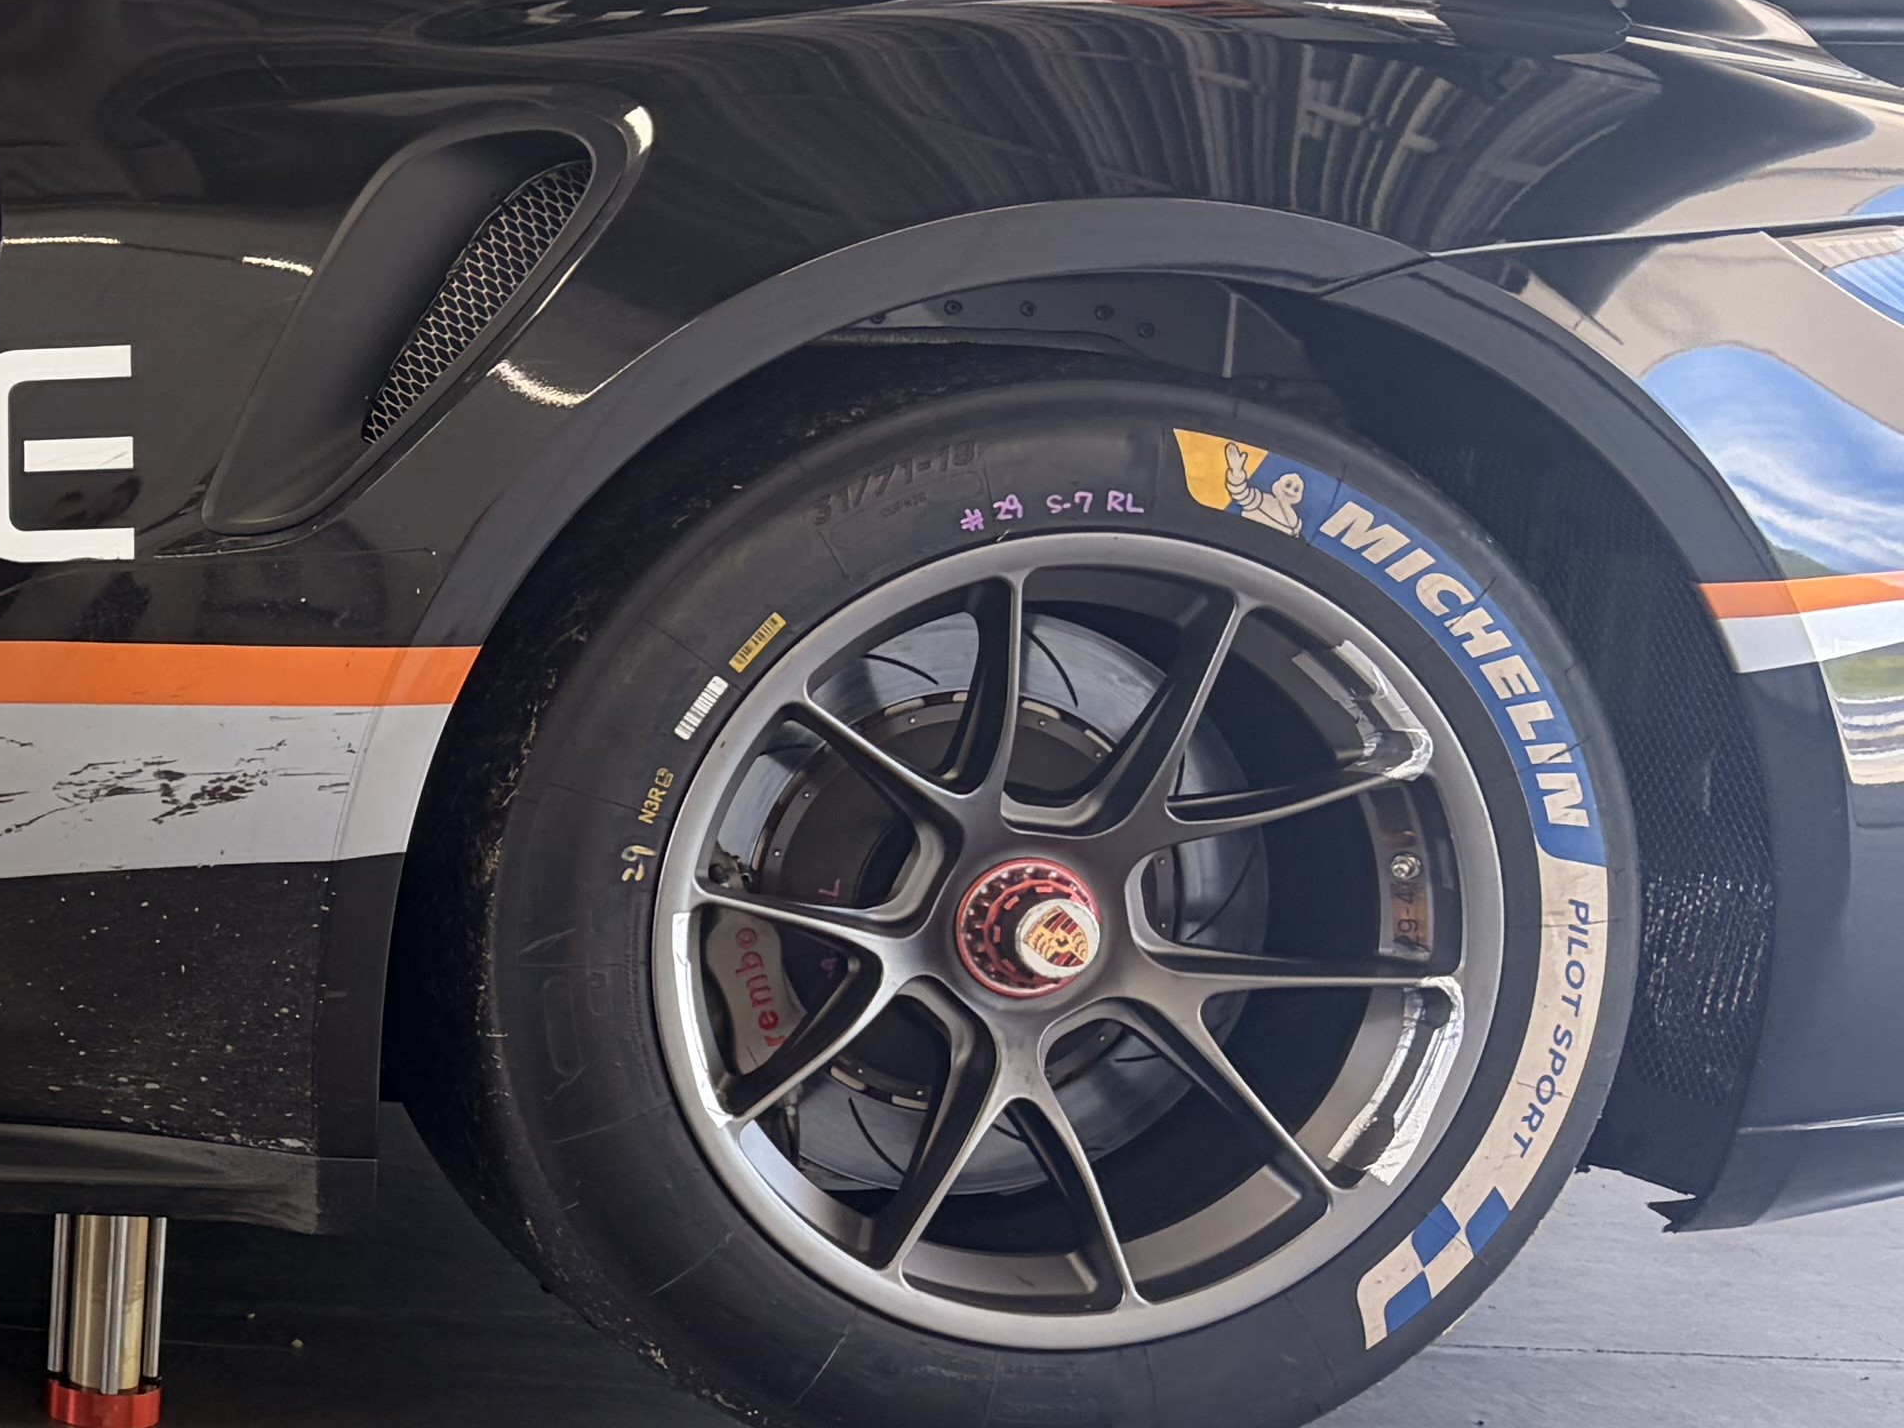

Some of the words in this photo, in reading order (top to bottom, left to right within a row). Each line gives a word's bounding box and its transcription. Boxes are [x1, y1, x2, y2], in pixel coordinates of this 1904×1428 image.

[1107, 490, 1144, 514] RL
[1319, 501, 1590, 827] MICHELIN
[1561, 899, 1590, 1017] PILOT
[1519, 1024, 1574, 1159] SPORT
